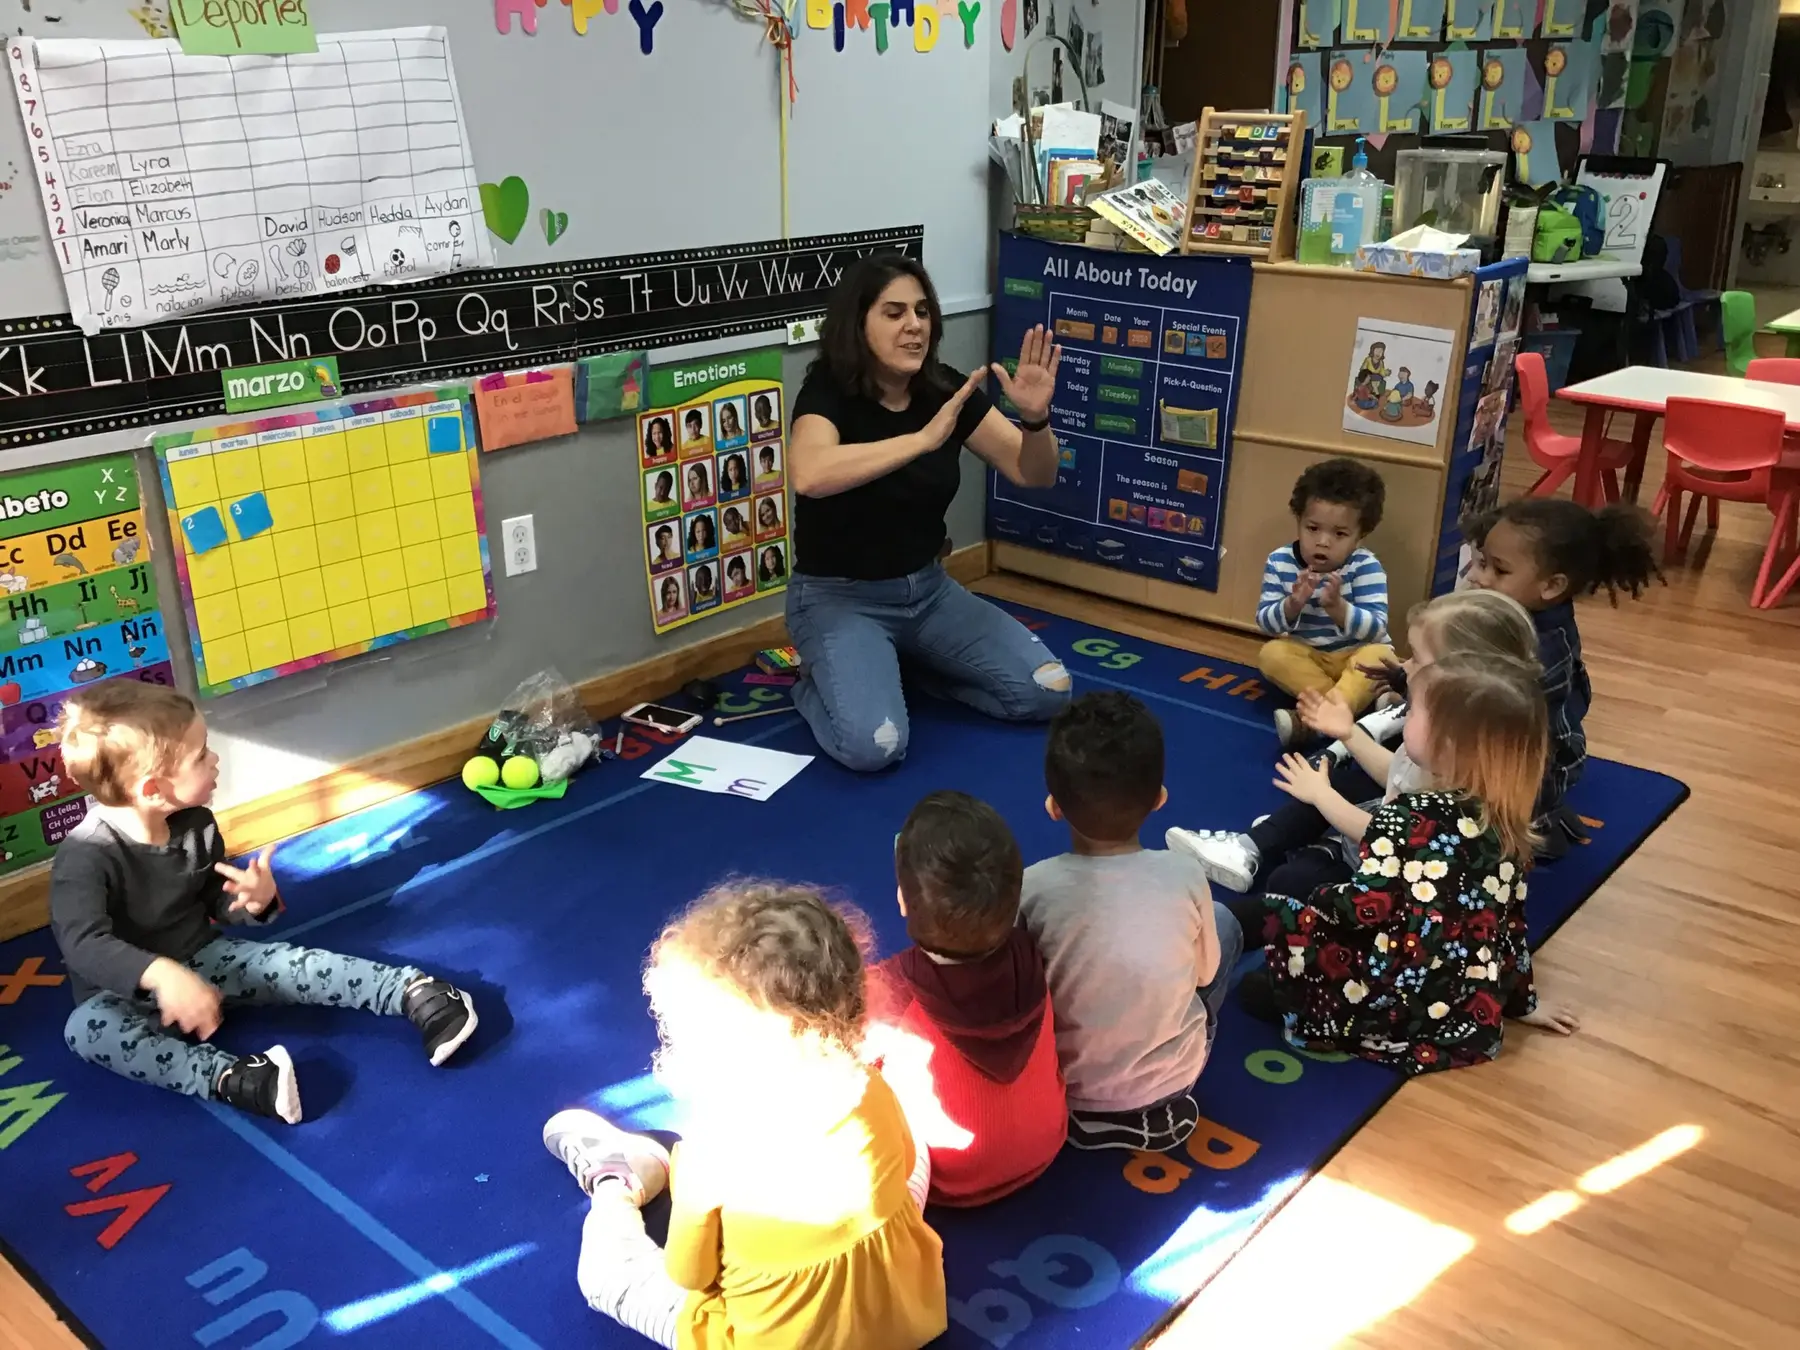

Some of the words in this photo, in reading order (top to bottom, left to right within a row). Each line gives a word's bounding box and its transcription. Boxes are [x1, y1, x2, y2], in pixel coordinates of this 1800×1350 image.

[12, 47, 24, 68] 9
[19, 73, 31, 92] 8
[24, 100, 36, 116] 7
[31, 122, 43, 139] 6
[38, 146, 50, 163] 5
[63, 138, 104, 157] Ezra
[67, 161, 119, 182] Kareem
[129, 154, 170, 175] Lyra
[45, 171, 56, 189] 4
[129, 178, 192, 197] Elizabeth
[51, 194, 61, 212] 3
[424, 190, 468, 216] Aydan
[76, 212, 131, 230] Veronica
[135, 204, 191, 223] Marcus
[264, 208, 308, 237] David
[318, 208, 362, 227] Hudson
[370, 203, 413, 224] Hedda
[1605, 194, 1639, 247] 2
[56, 217, 66, 234] 2
[83, 235, 128, 260] Amari
[142, 228, 190, 252] Marly
[62, 242, 70, 264] 1
[1043, 257, 1069, 278] All
[1074, 261, 1133, 287] About
[1138, 268, 1198, 299] Today
[156, 292, 204, 313] natación
[97, 312, 131, 327] Tenis
[142, 325, 232, 378] Mm
[250, 314, 311, 363] Nn
[329, 307, 386, 351] Oo
[392, 300, 436, 362] Pp
[457, 293, 518, 351] Qq
[532, 285, 572, 327] Rr
[573, 280, 605, 321] Ss
[620, 273, 653, 313] Tt
[672, 268, 711, 307] Uu
[717, 264, 748, 301] Vv
[759, 257, 803, 295] Ww
[815, 252, 843, 289] Xx
[1066, 307, 1089, 318] Month
[1104, 313, 1122, 323] Date
[1133, 317, 1150, 326] Year
[1172, 320, 1200, 333] Special
[1201, 324, 1227, 336] Events
[1059, 354, 1091, 368] esterday
[1075, 366, 1090, 375] was
[674, 362, 746, 388] Emotions
[228, 371, 305, 400] marzo
[1066, 381, 1089, 394] Today
[1104, 388, 1132, 401] Tuesday
[1163, 376, 1222, 394] Pick-A-Question
[1050, 404, 1087, 419] Tomorrow
[1061, 416, 1075, 426] will
[1076, 418, 1086, 428] be
[221, 438, 248, 449] martes
[351, 416, 375, 426] viernes
[1144, 452, 1178, 468] Season
[101, 469, 114, 483] X
[1116, 473, 1130, 484] The
[1132, 478, 1160, 489] season
[1161, 482, 1168, 491] is
[94, 490, 107, 504] Y
[115, 487, 128, 501] Z
[1133, 492, 1154, 503] Words
[1155, 498, 1165, 506] we
[1166, 499, 1185, 509] learn
[232, 503, 243, 516] 3
[185, 517, 195, 530] 2
[46, 526, 86, 556] Dd
[108, 519, 137, 541] Ee
[8, 593, 48, 620] Hh
[78, 578, 97, 602] Ii
[129, 565, 148, 594] Jj
[64, 637, 102, 660] Nn
[1072, 638, 1144, 670] Gg
[1179, 667, 1266, 701] Hh
[20, 757, 56, 780] Vv
[653, 758, 717, 785] M
[725, 778, 767, 797] m
[46, 811, 56, 819] LL
[58, 801, 80, 816] (elle)
[48, 820, 61, 830] CH
[63, 812, 84, 825] (che)
[51, 831, 63, 841] RR
[64, 1151, 173, 1251] Vv
